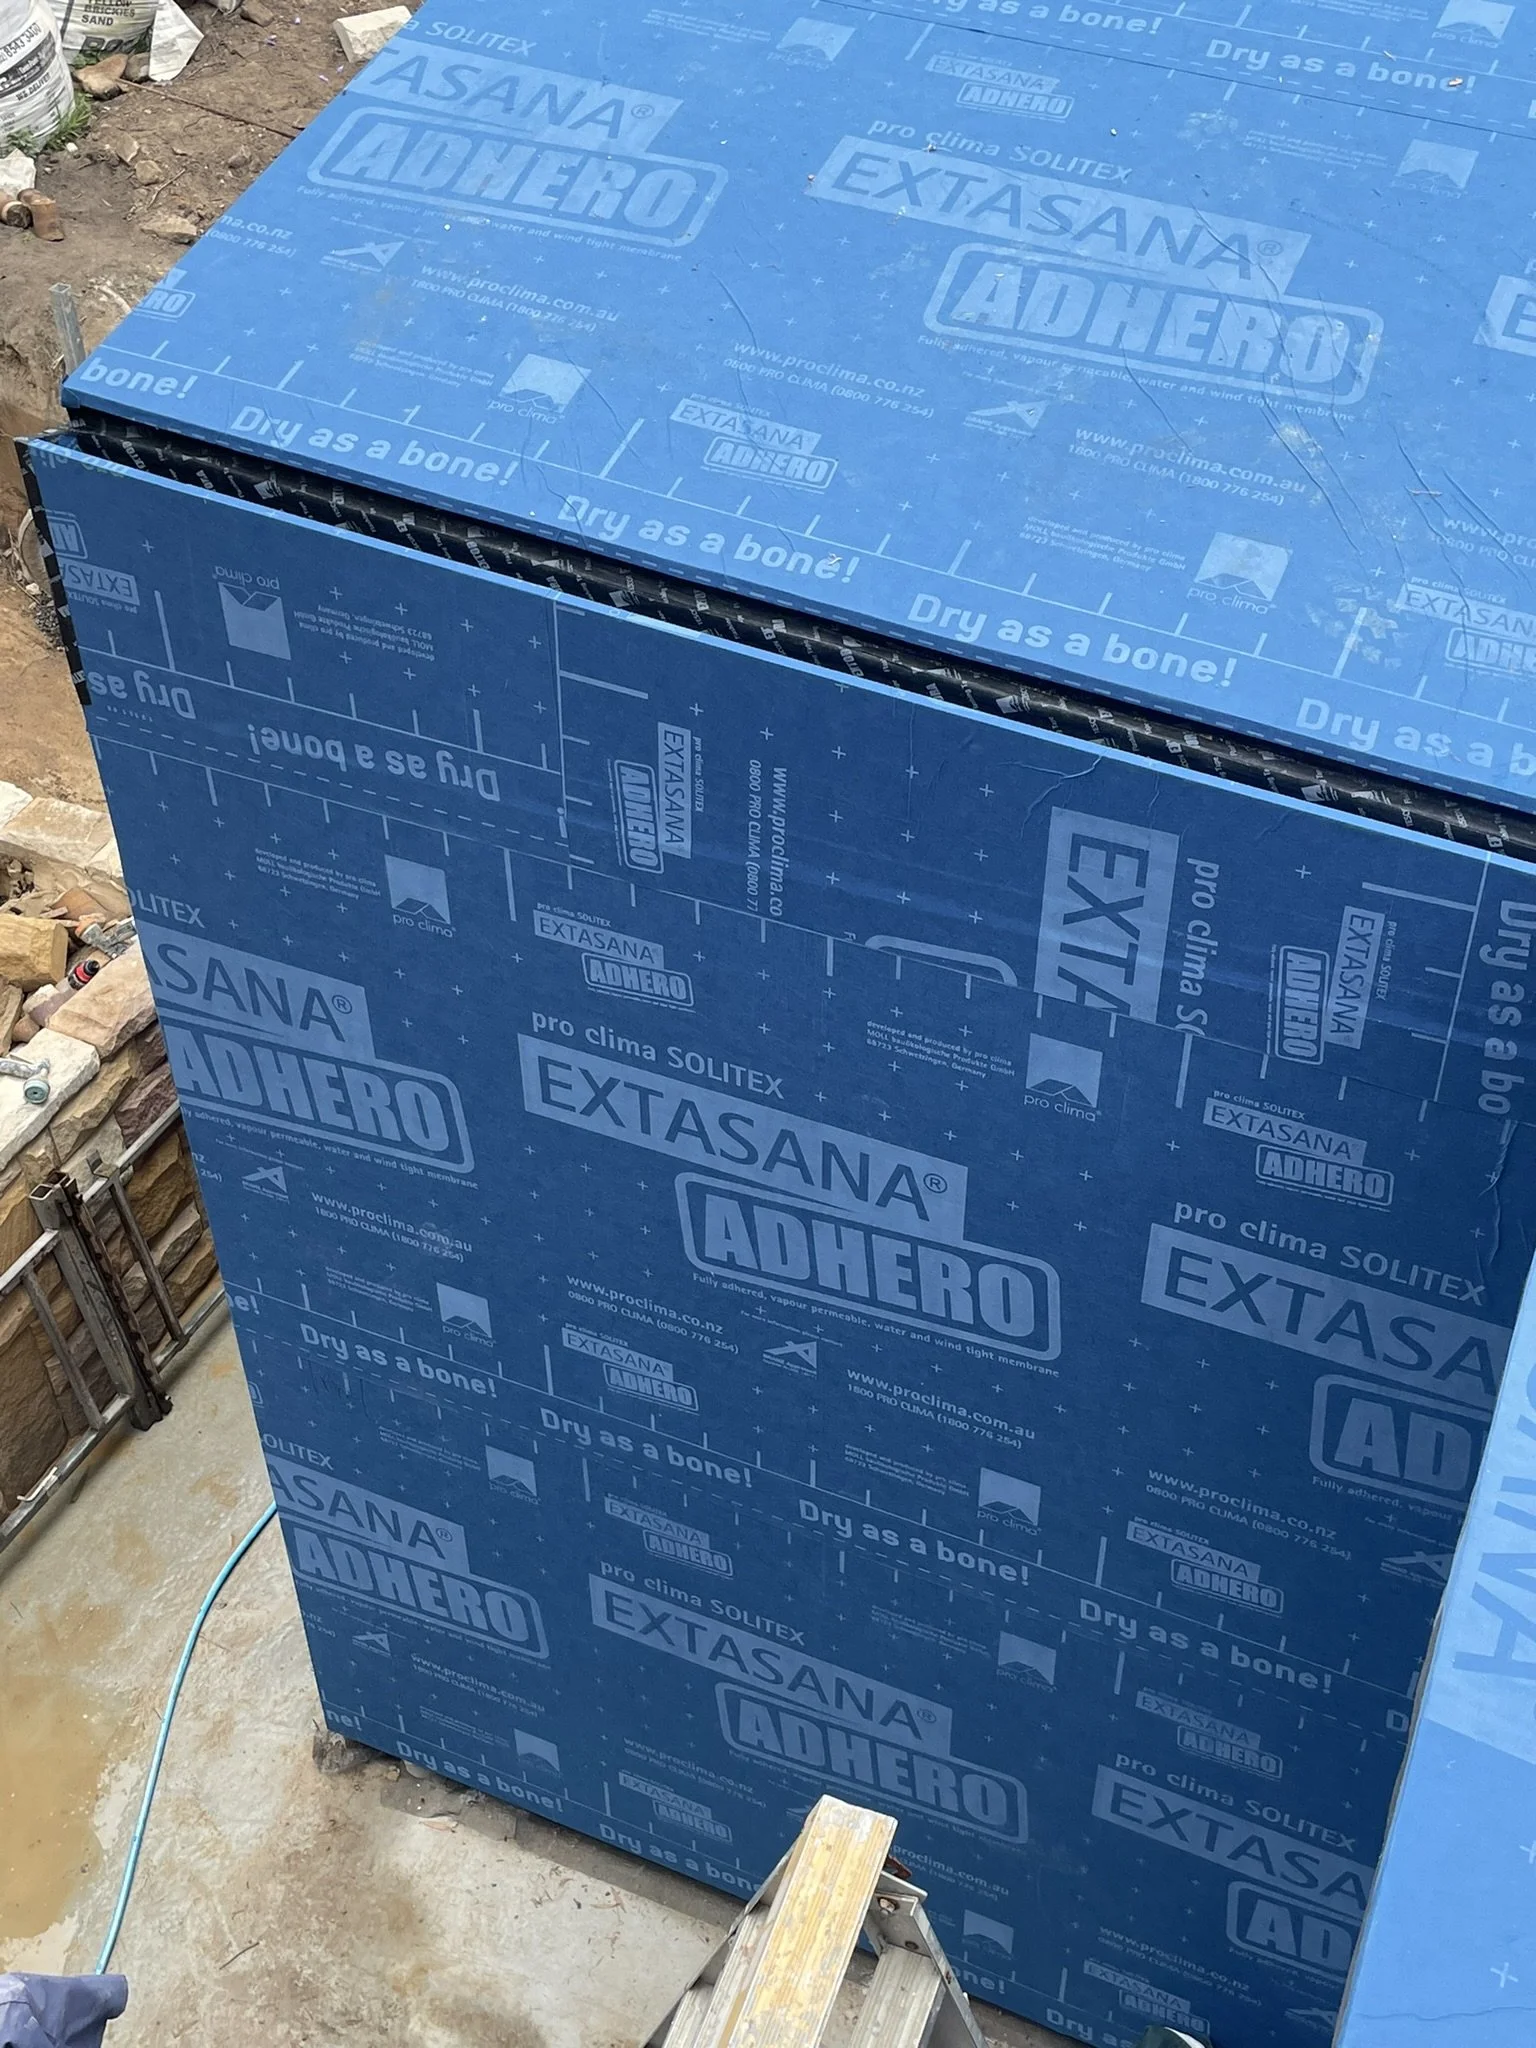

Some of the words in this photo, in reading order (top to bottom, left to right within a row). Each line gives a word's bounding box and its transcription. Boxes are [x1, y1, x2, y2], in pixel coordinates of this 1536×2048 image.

[82, 15, 114, 25] SAND
[426, 20, 537, 56] SOLITEX
[979, 0, 1020, 15] as
[1029, 5, 1049, 19] a
[1059, 5, 1163, 34] bone!
[1205, 39, 1270, 70] Dry
[1280, 53, 1324, 72] as
[1335, 62, 1356, 77] a
[962, 85, 1069, 115] ADHERO
[333, 121, 697, 229] ADHERO
[868, 120, 915, 138] pro
[926, 131, 1000, 156] clima
[1009, 144, 1132, 184] SOLITEX
[953, 261, 1350, 384] ADHERO
[79, 358, 200, 401] bone!
[734, 343, 926, 400] www.proclima.co.nz
[231, 406, 303, 448] Dry
[309, 428, 358, 453] as
[366, 438, 392, 459] a
[399, 441, 519, 486] bone!
[716, 444, 828, 483] ADHERO
[1076, 426, 1307, 494] www.proclima.com.au
[558, 495, 631, 541] Dry
[638, 519, 691, 546] as
[700, 532, 725, 554] a
[734, 534, 860, 583] bone!
[907, 592, 988, 642] Dry
[997, 618, 1053, 648] as
[1064, 632, 1091, 657] a
[1102, 633, 1238, 688] bone!
[87, 671, 128, 699] as
[133, 669, 196, 720] Dry
[248, 724, 347, 772] bone!
[354, 744, 375, 769] a
[1296, 697, 1380, 751] Dry
[1394, 723, 1452, 758] as
[1466, 741, 1494, 768] a
[385, 751, 427, 780] as
[436, 750, 501, 802] Dry
[663, 729, 684, 845] EXTASANA
[749, 759, 762, 792] 0800
[620, 765, 659, 867] ADHERO
[749, 795, 761, 819] PRO
[748, 821, 761, 860] CLIMA
[1187, 858, 1220, 910] pro
[540, 916, 655, 964] EXTASANA
[1179, 920, 1219, 997] clima
[589, 958, 687, 1000] ADHERO
[1330, 912, 1375, 1035] EXTASANA
[1283, 951, 1322, 1058] ADHERO
[1486, 983, 1526, 1029] as
[532, 1011, 575, 1038] pro
[585, 1026, 657, 1062] clima
[666, 1047, 785, 1100] SOLITEX
[1484, 1037, 1518, 1062] a
[164, 1022, 449, 1152] ADHERO
[1023, 1093, 1049, 1109] pro
[1054, 1101, 1097, 1122] clima
[1213, 1089, 1230, 1100] pro
[1234, 1093, 1261, 1107] clima
[1263, 1101, 1306, 1121] SOLITEX
[1211, 1105, 1352, 1161] EXTASANA
[1262, 1149, 1386, 1199] ADHERO
[311, 1191, 473, 1253] www.proclima.com.au
[705, 1194, 1035, 1338] ADHERO
[1173, 1201, 1227, 1229] pro
[1240, 1220, 1328, 1260] clima
[1340, 1245, 1486, 1306] SOLITEX
[566, 1274, 725, 1335] www.proclima.co.nz
[598, 1300, 619, 1314] PRO
[621, 1307, 653, 1326] CLIMA
[691, 1330, 712, 1345] 776
[693, 1272, 719, 1288] Fully
[771, 1293, 808, 1312] vapour
[874, 1320, 908, 1339] water
[910, 1332, 931, 1344] and
[934, 1338, 962, 1354] wind
[965, 1344, 994, 1363] tight
[998, 1354, 1061, 1378] membrane
[301, 1322, 349, 1360] Dry
[354, 1342, 388, 1368] as
[396, 1354, 411, 1374] a
[417, 1358, 498, 1399] bone!
[568, 1333, 666, 1377] EXTASANA
[610, 1366, 695, 1407] ADHERO
[846, 1368, 1036, 1441] www.proclima.com.au
[540, 1407, 593, 1447] Dry
[600, 1429, 634, 1452] as
[643, 1445, 659, 1460] a
[667, 1444, 753, 1488] bone!
[1149, 1469, 1339, 1541] www.proclima.co.nz
[650, 1534, 727, 1571] ADHERO
[799, 1499, 853, 1539] Dry
[862, 1521, 900, 1546] as
[909, 1537, 927, 1555] a
[937, 1539, 1030, 1587] bone!
[1133, 1525, 1249, 1579] EXTASANA
[293, 1527, 530, 1643] ADHERO
[599, 1560, 636, 1584] pro
[644, 1577, 703, 1608] clima
[709, 1599, 806, 1646] SOLITEX
[1176, 1562, 1279, 1610] ADHERO
[1079, 1599, 1139, 1640] Dry
[1149, 1623, 1191, 1651] as
[1201, 1638, 1221, 1660] a
[1230, 1645, 1334, 1694] bone!
[396, 1740, 437, 1770] Dry
[443, 1762, 471, 1780] as
[477, 1774, 490, 1786] a
[495, 1776, 564, 1813] bone!
[737, 1700, 1008, 1825] ADHERO
[1182, 1728, 1277, 1775] ADHERO
[1114, 1753, 1157, 1777] pro
[1166, 1771, 1234, 1807] clima
[1245, 1799, 1356, 1852] SOLITEX
[599, 1823, 642, 1854] Dry
[648, 1846, 678, 1864] as
[684, 1858, 699, 1872] a
